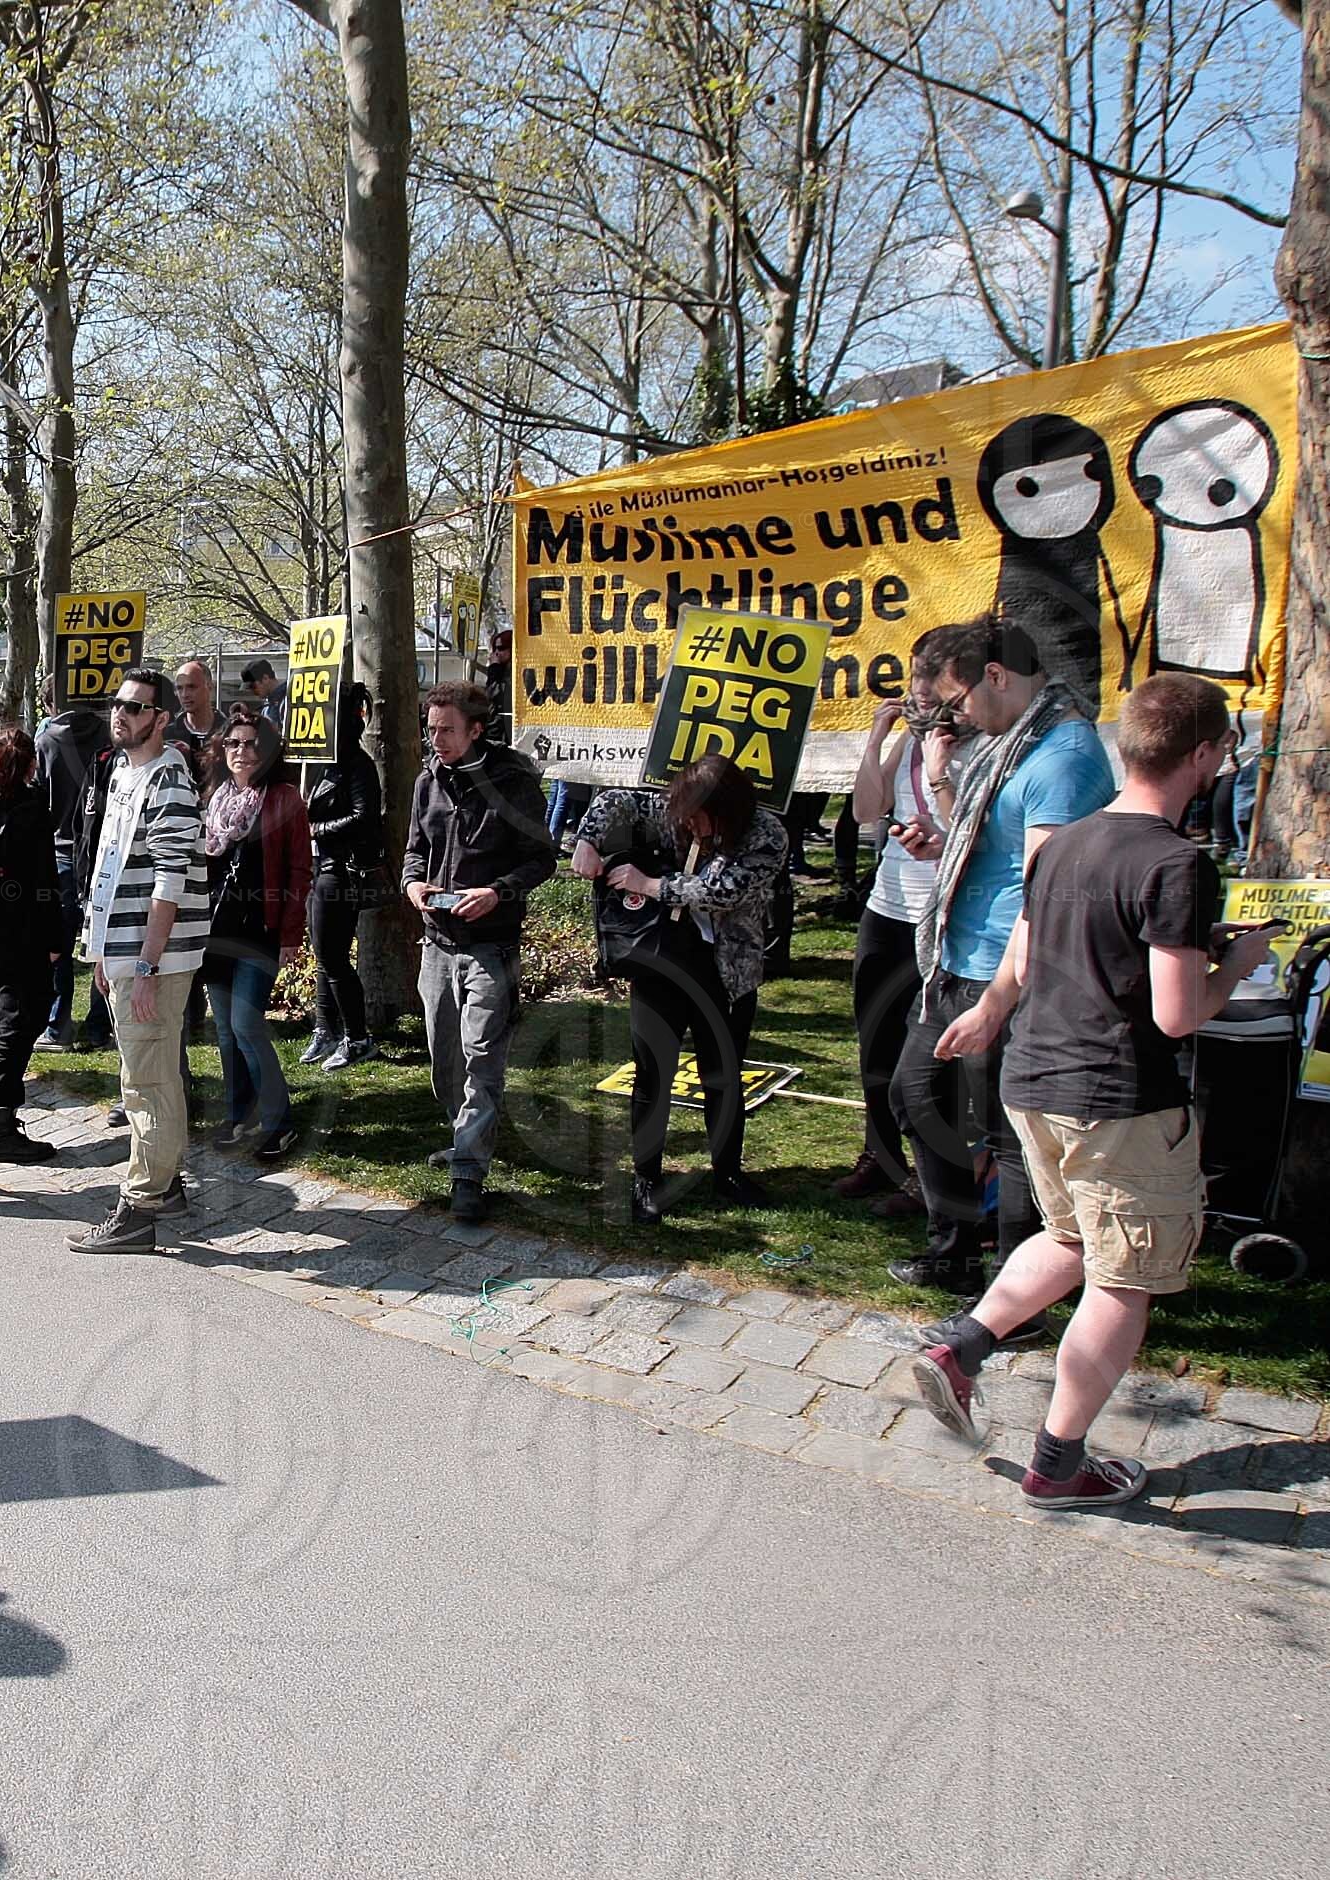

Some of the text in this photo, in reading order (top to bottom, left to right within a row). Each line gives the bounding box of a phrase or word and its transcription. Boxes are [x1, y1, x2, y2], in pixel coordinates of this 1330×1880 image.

[588, 500, 615, 519] ile
[814, 477, 961, 549] und
[64, 600, 135, 630] #NO
[527, 567, 909, 637] Flüchtlinge
[67, 637, 131, 665] PEG
[294, 628, 335, 663] #NO
[688, 626, 807, 674] #NO
[67, 667, 124, 695] IDA
[291, 670, 331, 704] PEG
[680, 675, 791, 731] PEG
[289, 706, 327, 740] IDA
[670, 719, 774, 779] IDA
[1241, 888, 1318, 903] MUSLIME
